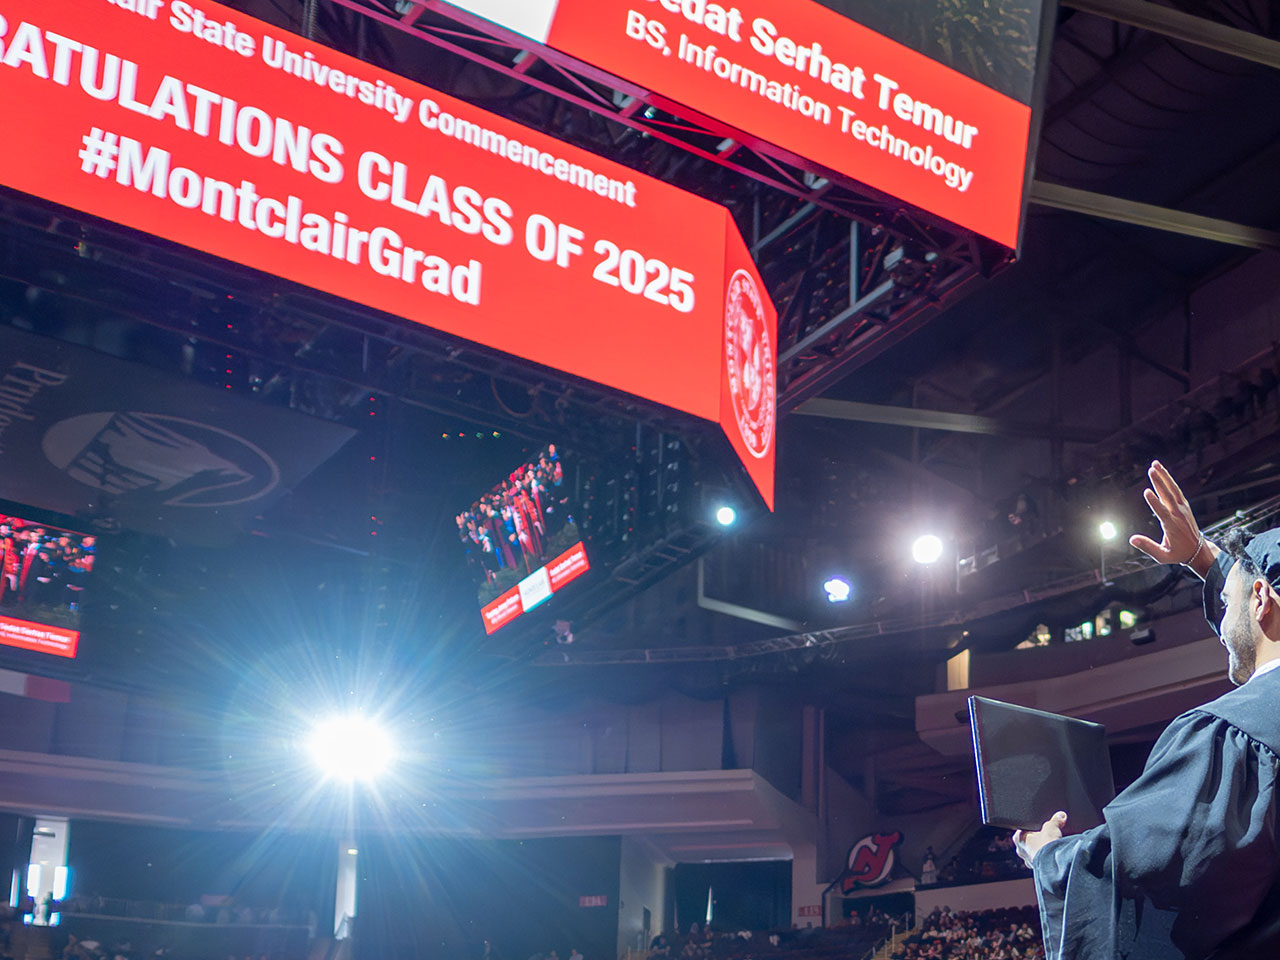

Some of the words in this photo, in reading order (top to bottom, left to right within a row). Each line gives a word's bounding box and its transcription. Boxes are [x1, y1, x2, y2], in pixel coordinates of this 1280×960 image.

[169, 0, 256, 57] State
[261, 34, 412, 122] University
[417, 100, 638, 207] Commencement
[626, 9, 672, 57] BS,
[678, 33, 832, 125] Information
[837, 106, 974, 193] Technology
[749, 17, 866, 99] Serhat
[873, 73, 978, 149] Temur
[78, 126, 483, 306] #MontclairGrad
[357, 150, 514, 245] CLASS
[525, 212, 587, 270] OF
[592, 237, 696, 313] 2025
